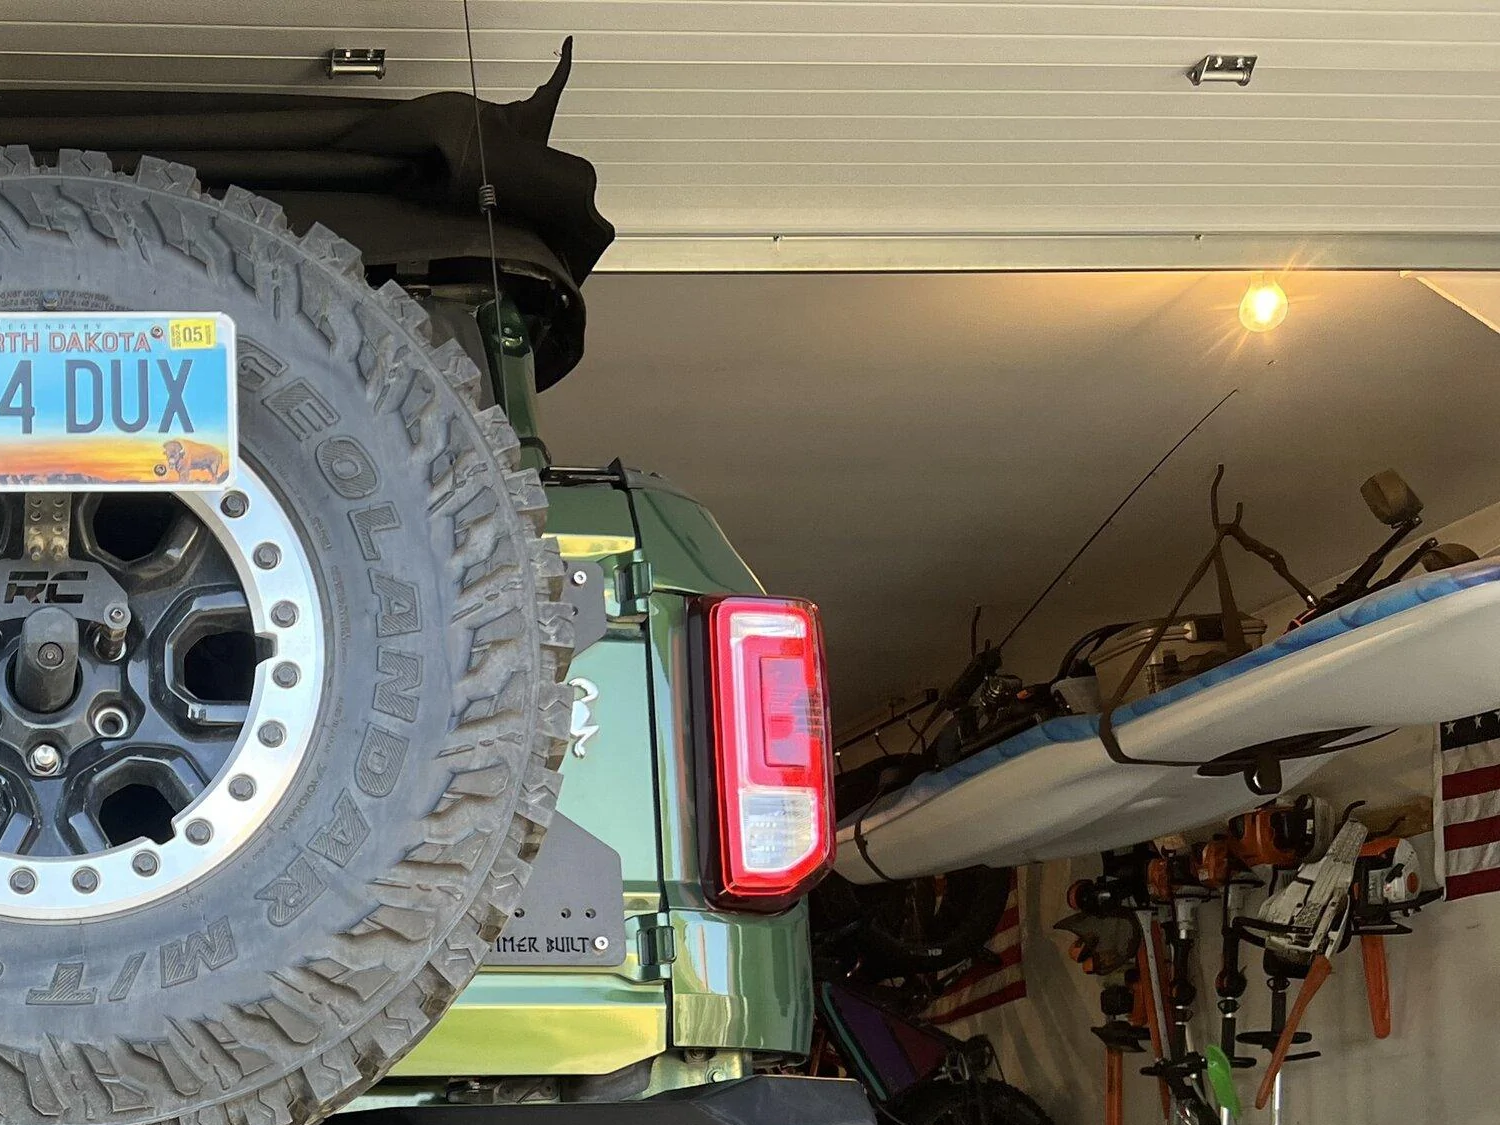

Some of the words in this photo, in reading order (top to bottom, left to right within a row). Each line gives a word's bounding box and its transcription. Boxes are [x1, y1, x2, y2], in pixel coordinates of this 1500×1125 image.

[49, 331, 151, 353] DAKOTA
[64, 359, 195, 434] DUX
[4, 570, 89, 604] RC
[25, 915, 239, 1006] M/T
[546, 937, 590, 953] BUILT
